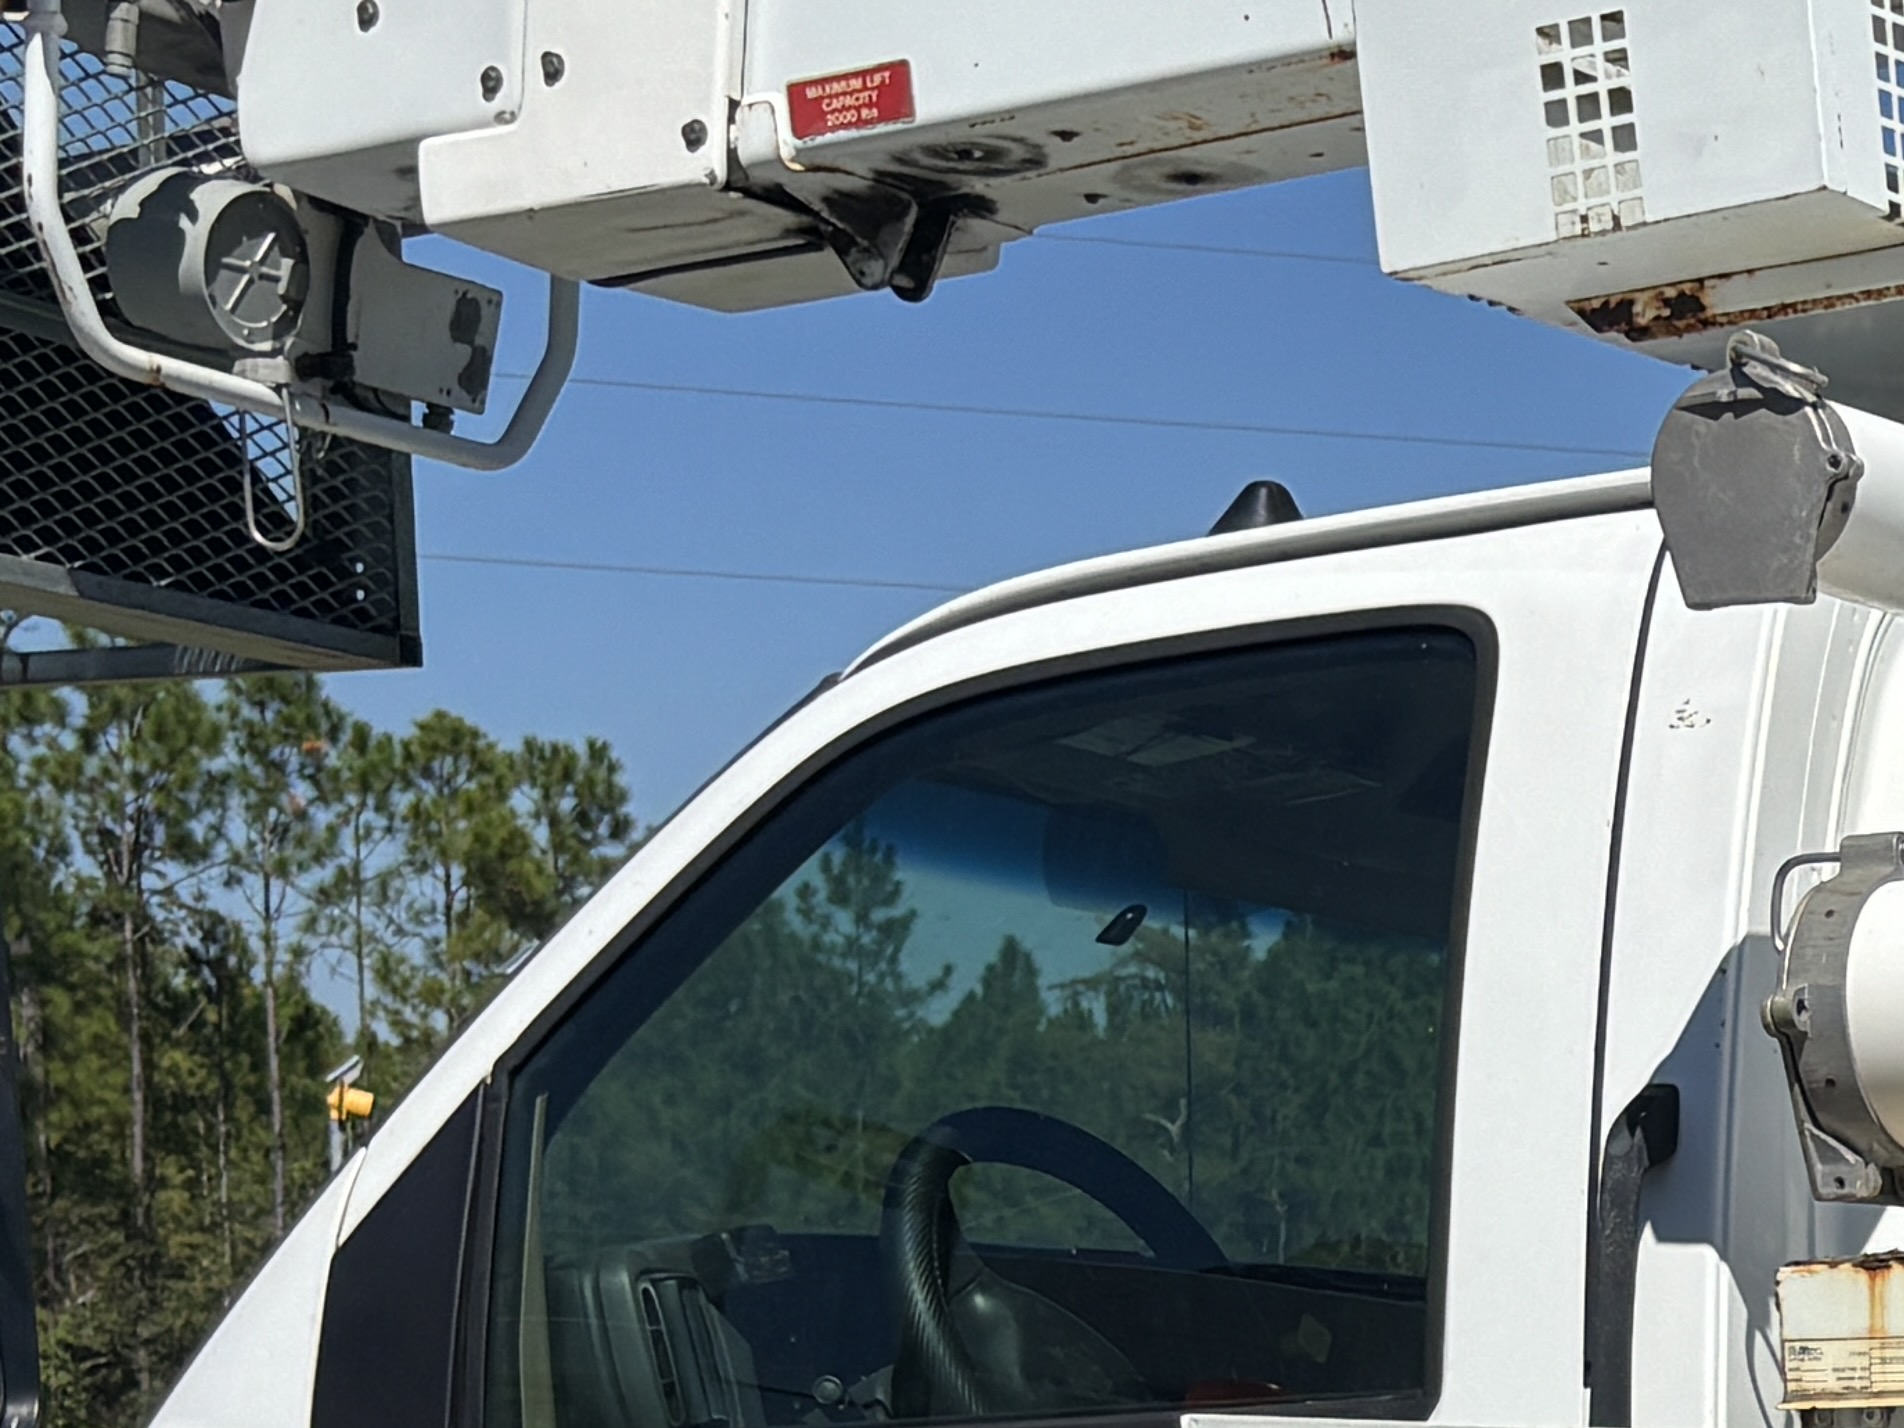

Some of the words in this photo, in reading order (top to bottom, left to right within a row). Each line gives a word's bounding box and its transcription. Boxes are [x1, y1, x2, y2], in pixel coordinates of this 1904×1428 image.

[805, 77, 863, 99] MAXIMUM
[866, 71, 891, 88] LIFT
[822, 90, 879, 112] CAPACITY
[826, 110, 858, 127] 2000
